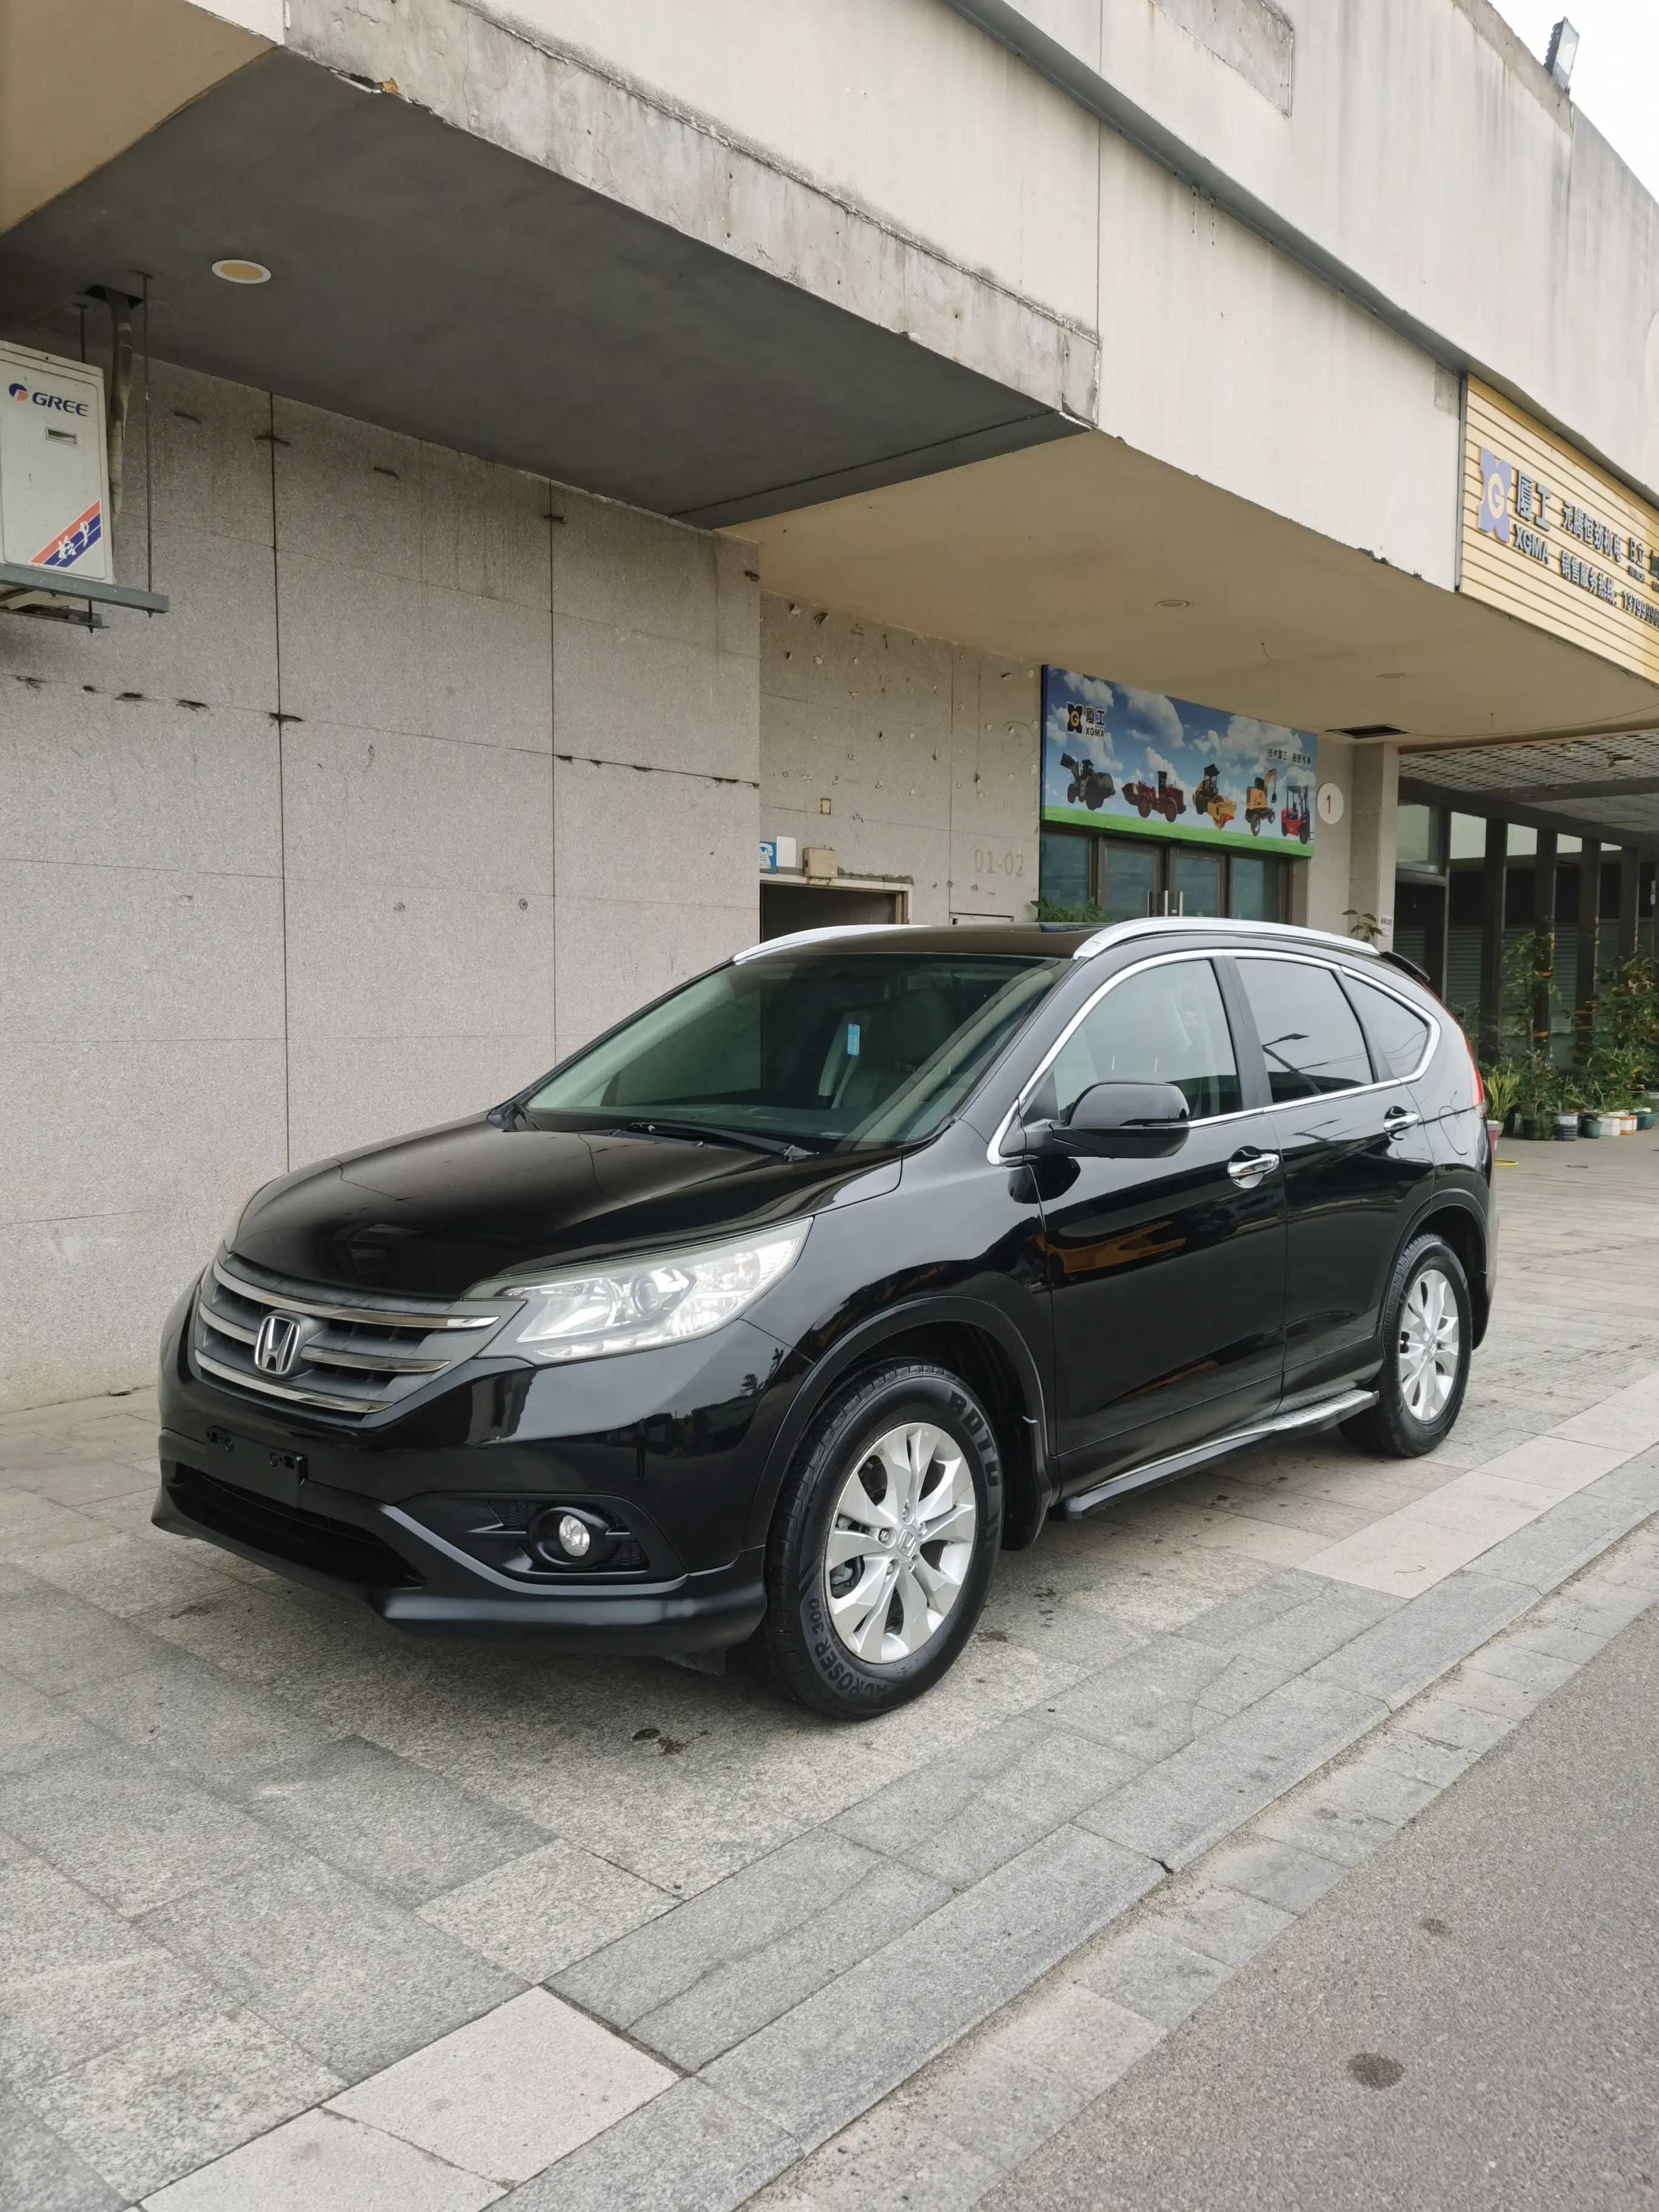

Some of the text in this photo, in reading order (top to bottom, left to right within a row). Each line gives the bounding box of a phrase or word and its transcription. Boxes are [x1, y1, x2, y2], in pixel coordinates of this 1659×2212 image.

[32, 392, 89, 417] GREE
[1515, 470, 1552, 531] 厦工
[1513, 524, 1549, 564] XGMA
[1561, 500, 1622, 562] 元腾恒劲机电
[1628, 537, 1645, 569] 日立
[1621, 590, 1659, 628] 13799996
[1085, 726, 1105, 738] XGMA
[1086, 707, 1105, 726] 厦工
[1326, 794, 1331, 814] 1
[950, 1390, 1000, 1487] BOTO
[808, 1597, 825, 1635] 300
